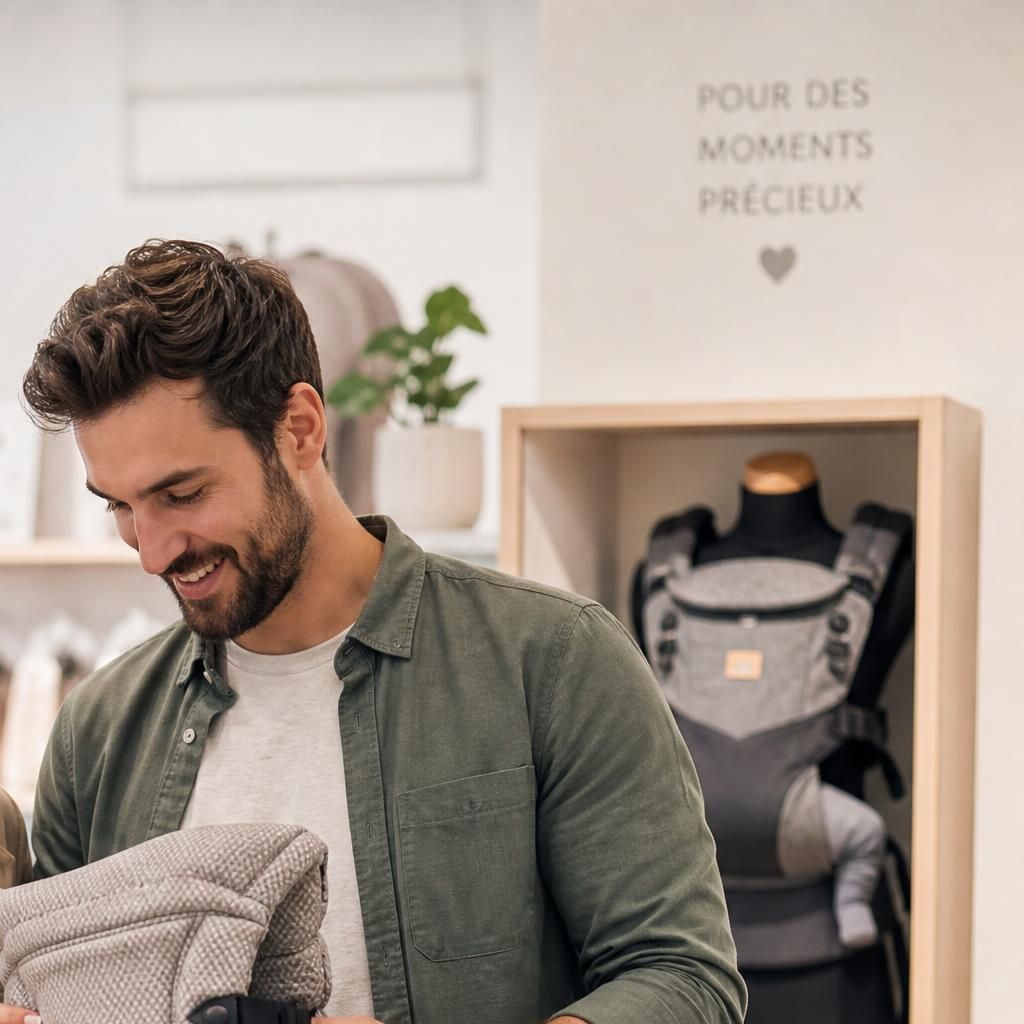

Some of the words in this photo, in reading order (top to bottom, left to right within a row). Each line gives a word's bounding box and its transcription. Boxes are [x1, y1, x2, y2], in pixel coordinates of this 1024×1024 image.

[698, 81, 791, 113] POUR
[806, 78, 870, 109] DES
[698, 130, 873, 163] MOMENTS
[699, 180, 863, 215] PRÉCIEUX
